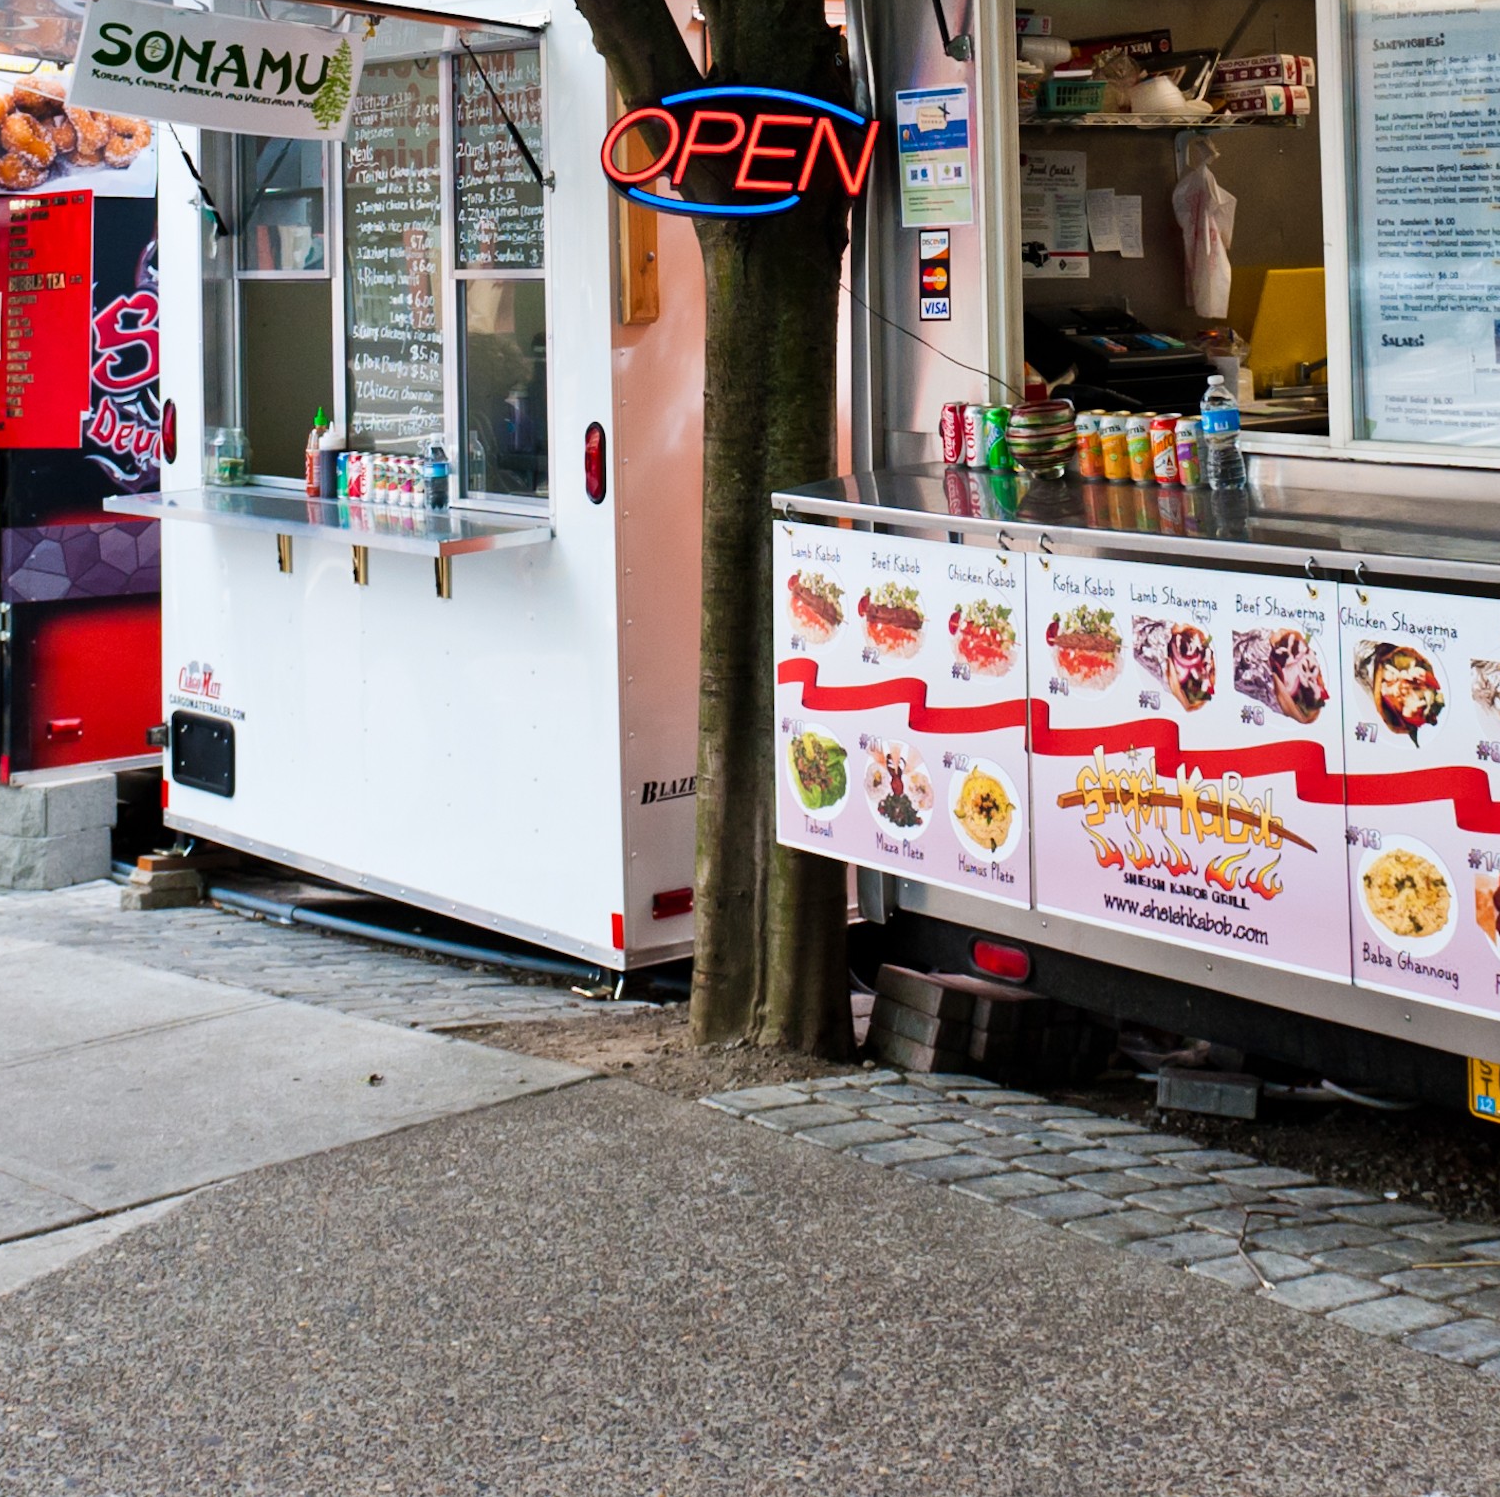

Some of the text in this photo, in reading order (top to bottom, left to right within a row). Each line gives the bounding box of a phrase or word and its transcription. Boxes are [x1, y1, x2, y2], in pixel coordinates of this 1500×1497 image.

[91, 22, 331, 96] SONAMU
[601, 107, 880, 196] OPEN
[46, 273, 65, 289] TEA
[924, 301, 948, 315] VISA
[791, 542, 841, 563] Lamb Kabob
[872, 552, 921, 574] Beef Kabob
[948, 564, 1016, 589] Chicken Kabob
[1053, 574, 1115, 598] Kofta Kabob
[1130, 583, 1218, 612] Lamb Shawerma
[1236, 595, 1326, 623] Beef Shawerma
[1340, 607, 1458, 639] Chicken Shawerma
[861, 647, 880, 665] #2
[951, 662, 970, 682] #3
[1049, 677, 1069, 696] #4
[1139, 690, 1161, 711] #5
[1240, 705, 1265, 726] #6
[1354, 721, 1378, 744] #7
[804, 815, 834, 838] Tabouli
[1345, 825, 1382, 850] #13
[876, 833, 924, 861] Maza Plate
[958, 854, 1015, 884] Humus Plate
[1123, 872, 1249, 910] SHEISH KABOB GRILL
[1104, 893, 1269, 945] www.sheishkabob.com
[1362, 942, 1460, 990] Baba Ghannoug
